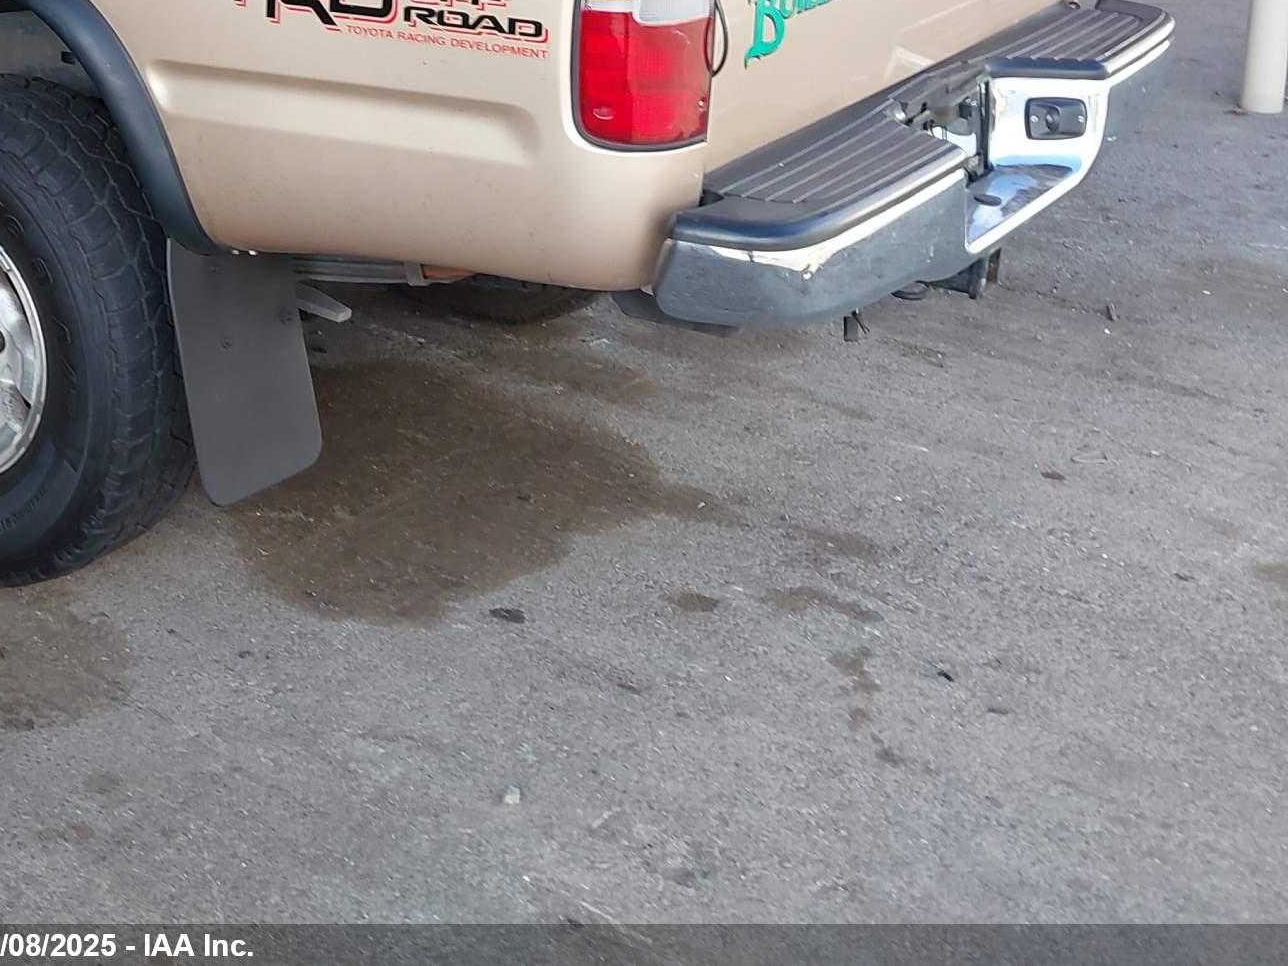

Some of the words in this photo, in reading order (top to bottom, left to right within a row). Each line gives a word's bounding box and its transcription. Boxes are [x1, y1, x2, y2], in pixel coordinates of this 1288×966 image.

[346, 23, 394, 40] TOYOTA
[396, 30, 446, 48] RACING
[449, 38, 549, 60] DEVELOPMENT
[403, 5, 550, 44] ROAD
